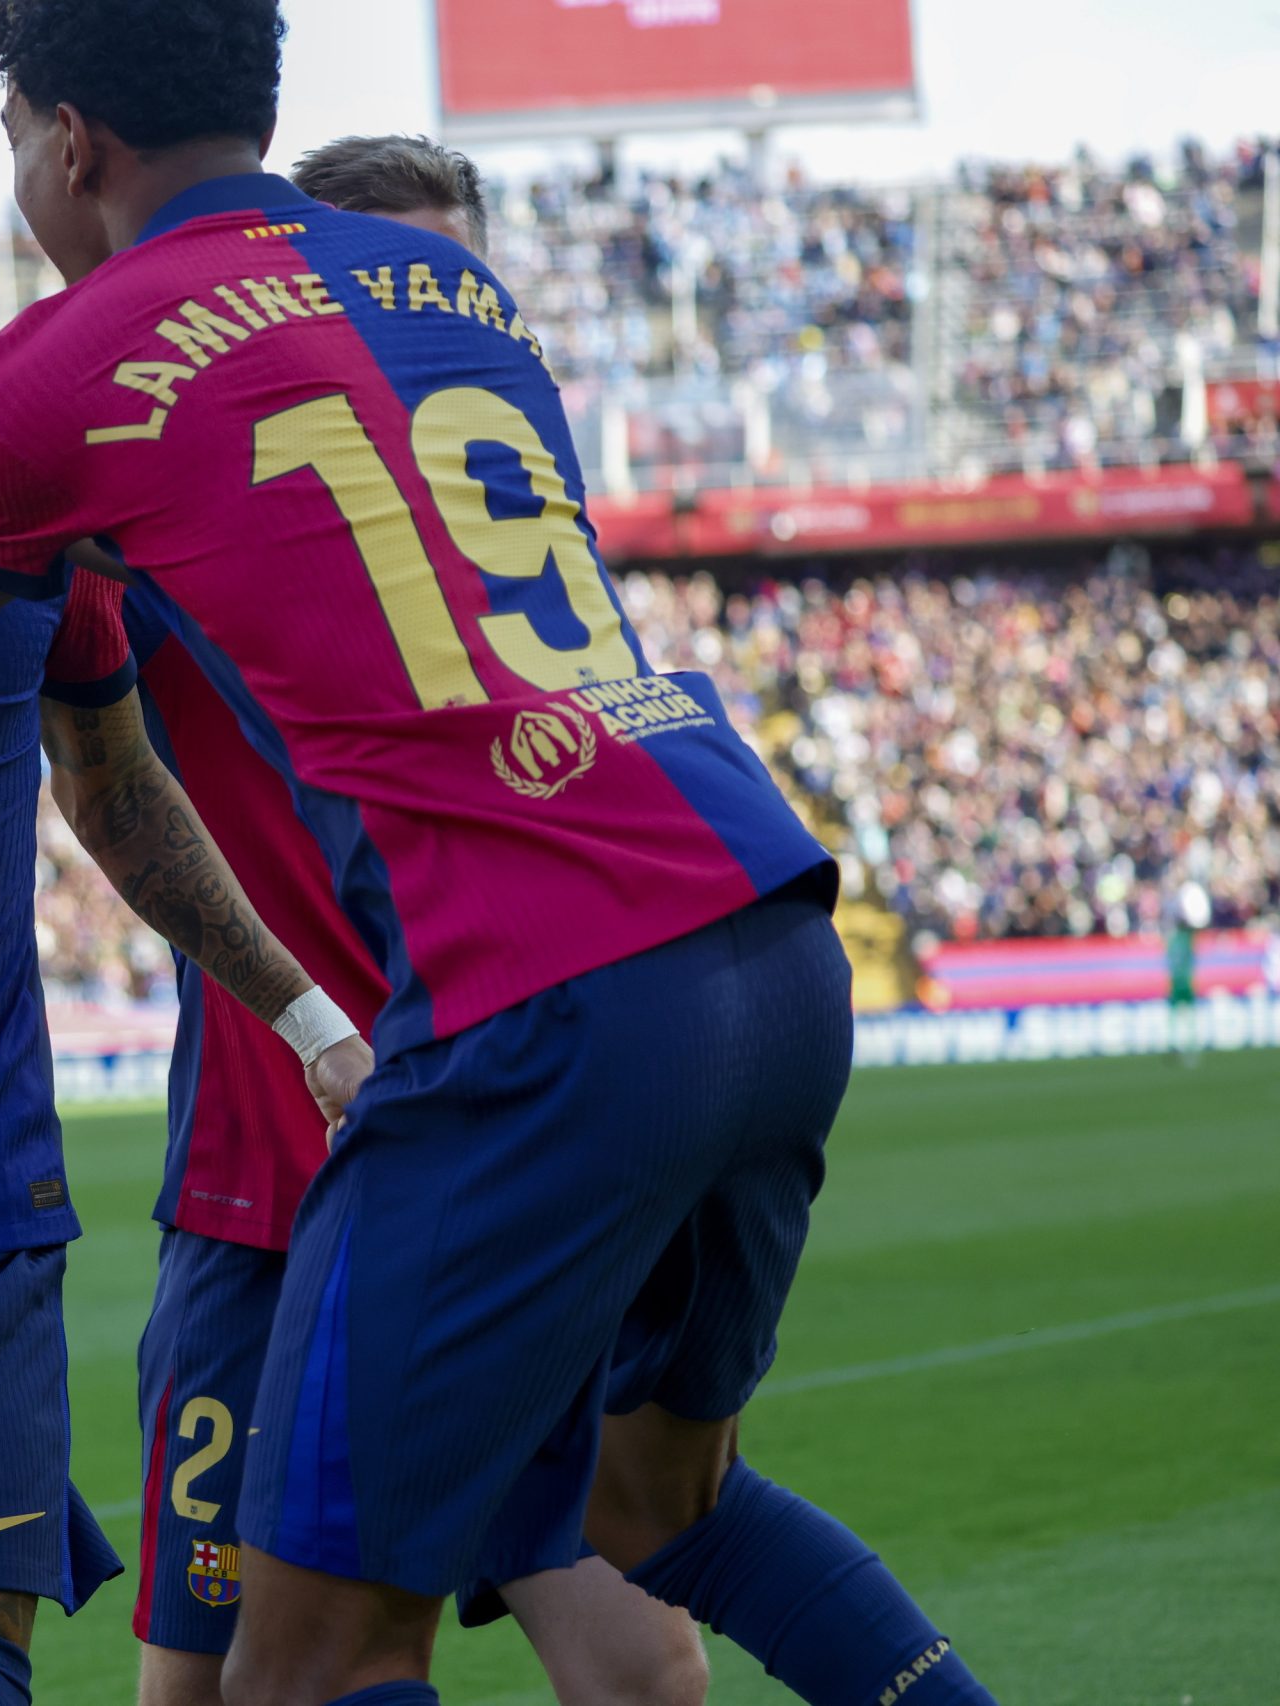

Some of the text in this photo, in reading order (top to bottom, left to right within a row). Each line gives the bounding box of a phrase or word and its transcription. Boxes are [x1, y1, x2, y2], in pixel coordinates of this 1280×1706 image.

[85, 263, 556, 445] LAMINE YAMA
[248, 385, 638, 712] 19
[568, 675, 683, 713] UNHCR
[597, 693, 707, 737] ACNUR
[171, 1396, 234, 1524] 2
